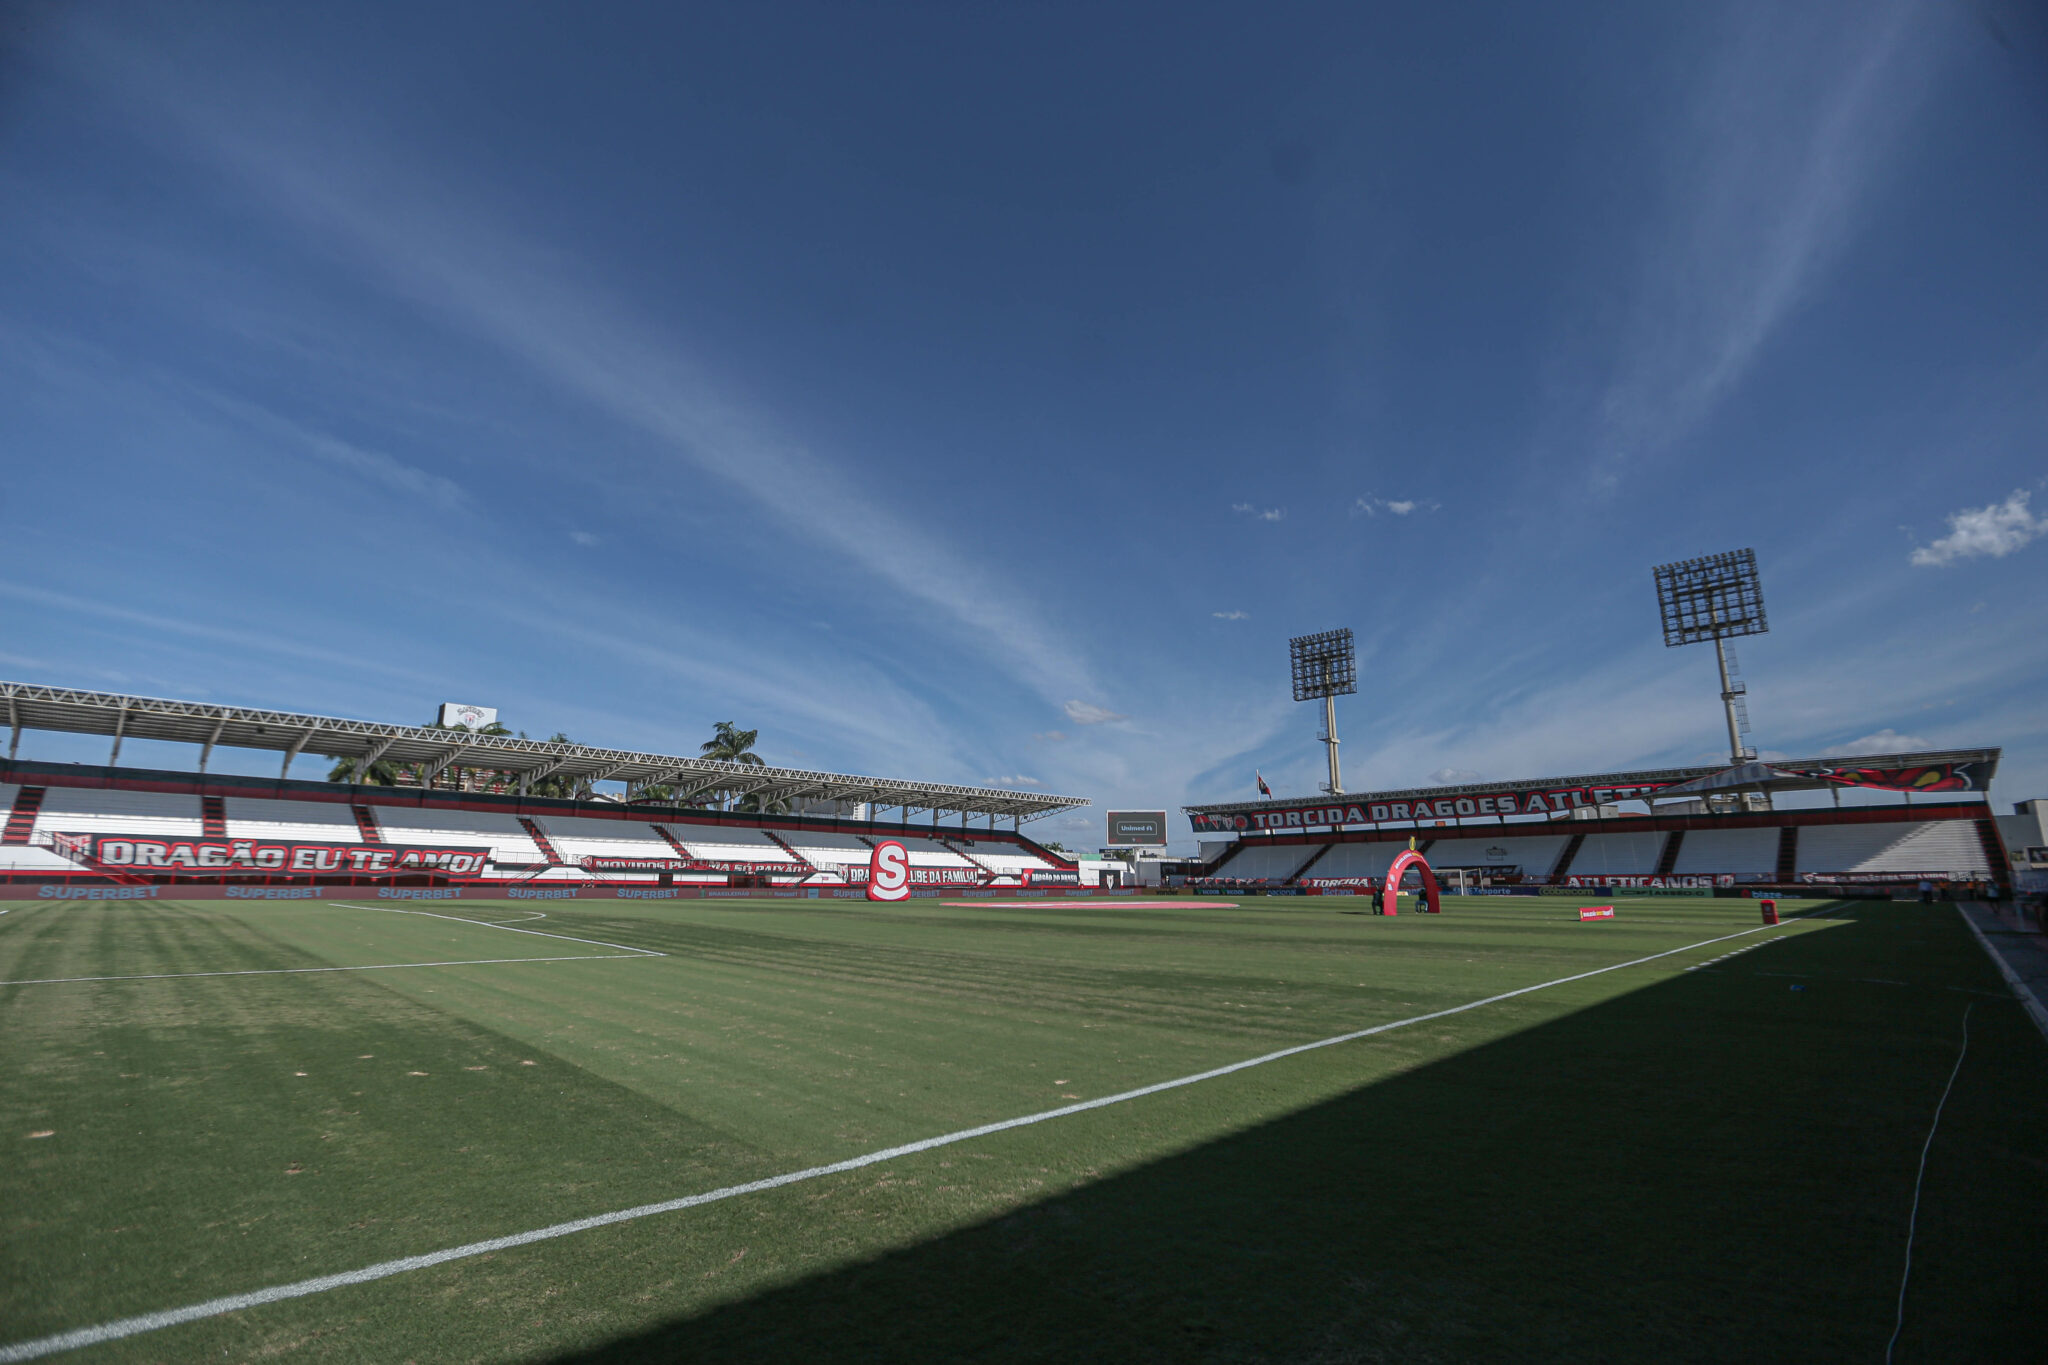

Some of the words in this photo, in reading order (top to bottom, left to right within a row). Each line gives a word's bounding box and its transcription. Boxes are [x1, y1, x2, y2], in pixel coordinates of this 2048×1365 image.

[1254, 807, 1365, 830] TORCIDA
[101, 841, 286, 868] DRAGÃO
[293, 848, 342, 870] EU
[350, 851, 392, 870] TE
[397, 852, 485, 873] AMO!
[876, 844, 907, 889] S
[850, 868, 870, 882] DRA
[908, 870, 928, 883] LUBE
[929, 871, 941, 883] DA
[942, 868, 978, 884] FAMÍLIA!
[1568, 876, 1713, 888] ATLETICANOS
[1313, 878, 1369, 887] TORCIDA
[37, 885, 161, 900] SUPERBET
[225, 886, 325, 899] SUPERBET
[378, 887, 463, 900] SUPERBET
[508, 888, 578, 899] SUPERBET
[617, 888, 679, 899] SUPERBET
[963, 889, 997, 898] SUPERBET
[1016, 889, 1048, 897] SUPERBET
[1751, 890, 1782, 898] blaze
